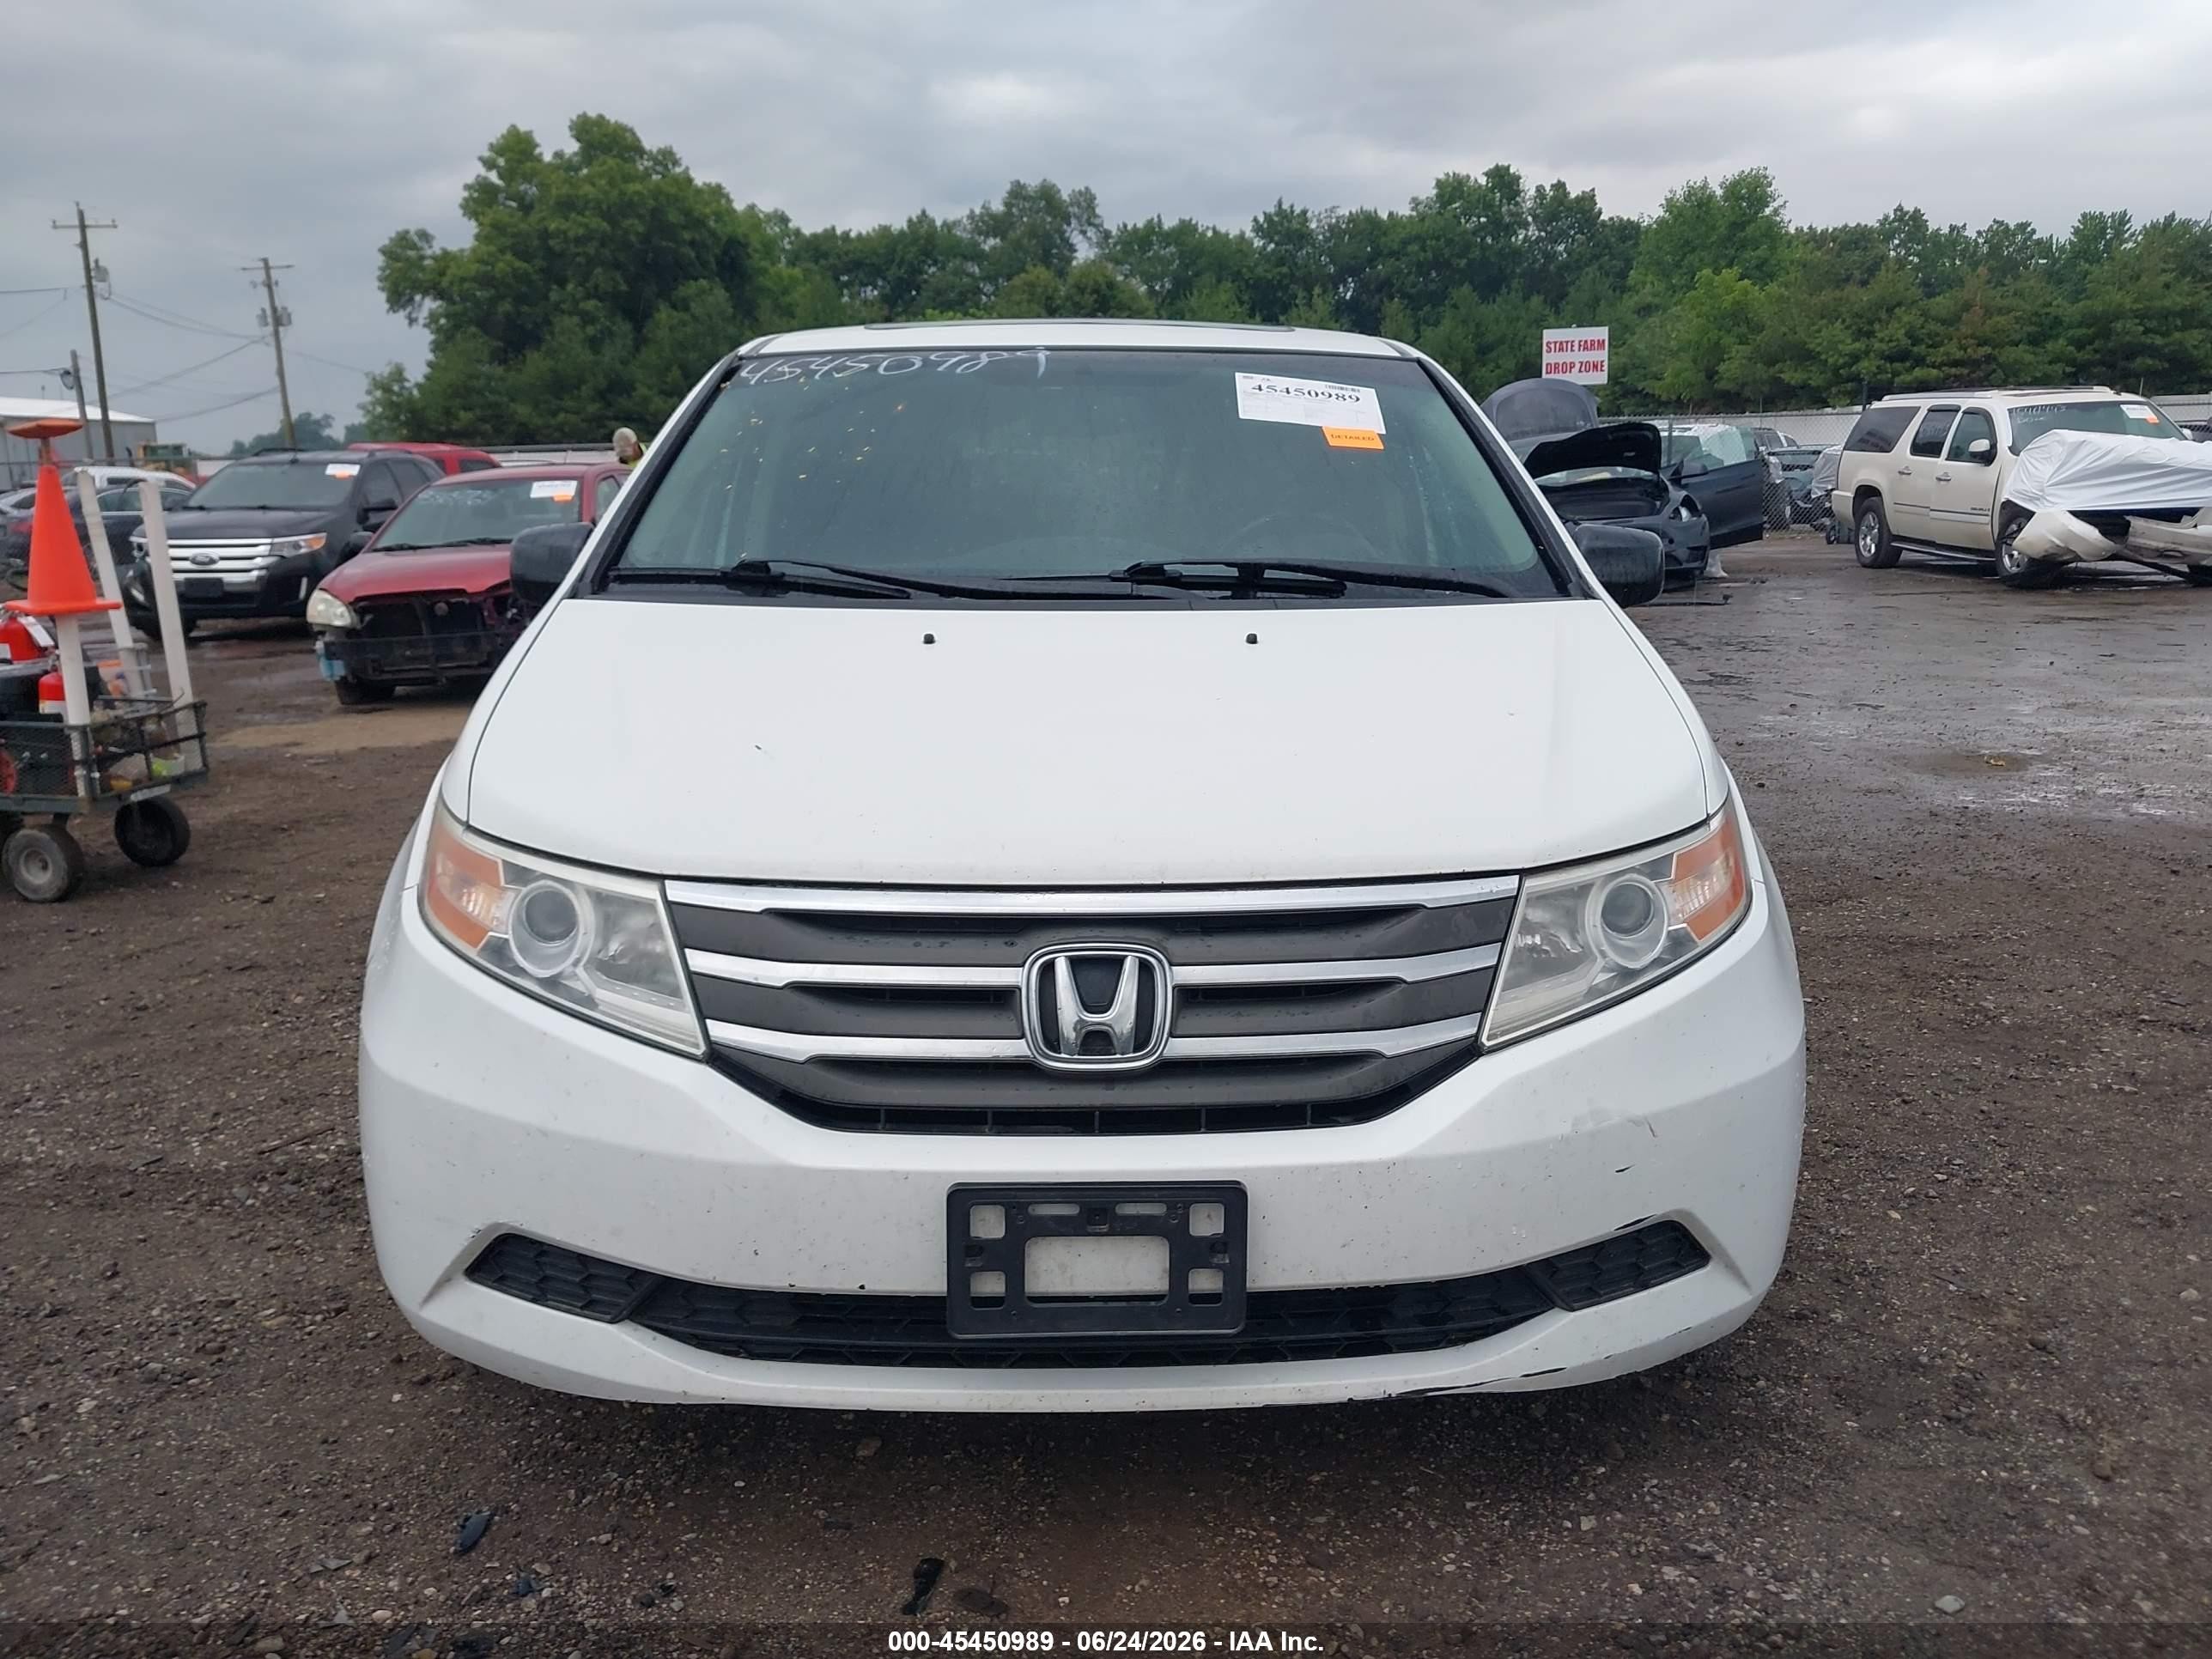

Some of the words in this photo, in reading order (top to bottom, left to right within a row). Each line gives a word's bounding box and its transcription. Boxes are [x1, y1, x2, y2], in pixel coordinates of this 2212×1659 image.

[1546, 340, 1575, 353] STATE
[1578, 338, 1606, 352] FARM
[740, 347, 1051, 385] 45450989
[1546, 362, 1576, 374] DROP
[1578, 360, 1606, 374] ZONE
[1251, 384, 1361, 403] 45450989
